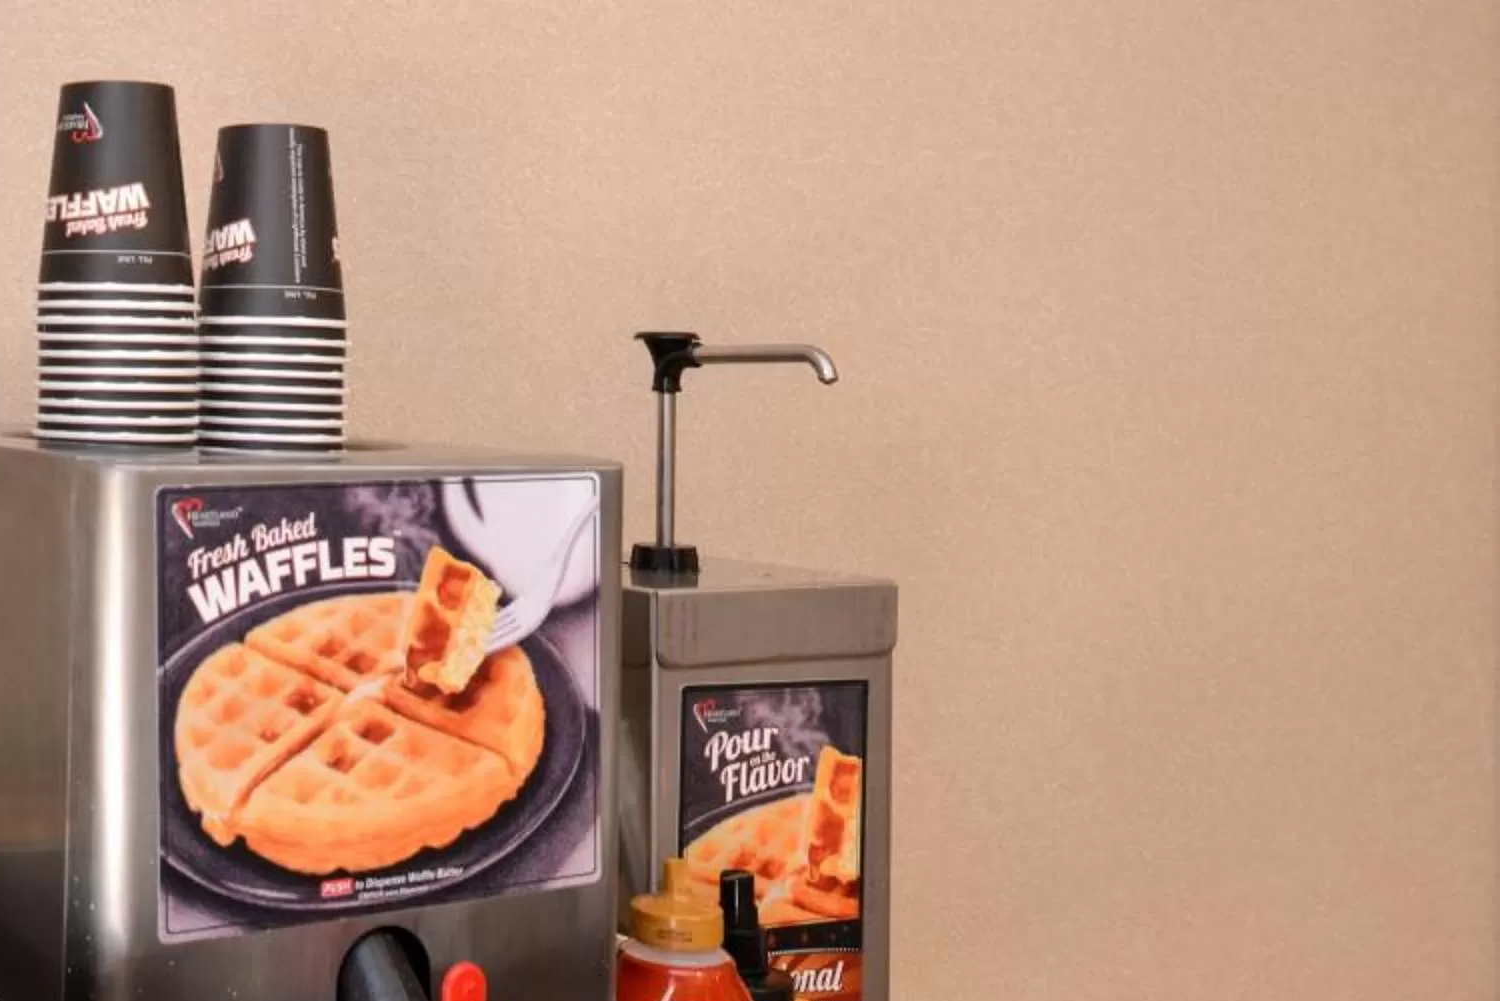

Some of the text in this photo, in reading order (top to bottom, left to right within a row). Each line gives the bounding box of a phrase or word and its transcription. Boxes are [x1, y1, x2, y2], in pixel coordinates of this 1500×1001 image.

[46, 182, 150, 221] WAFFLE
[107, 211, 148, 232] Fresh
[204, 217, 258, 253] WAF
[187, 511, 317, 579] Fresh Baked
[186, 536, 398, 624] WAFFLES
[703, 727, 779, 773] Pour
[720, 756, 811, 803] Flavor
